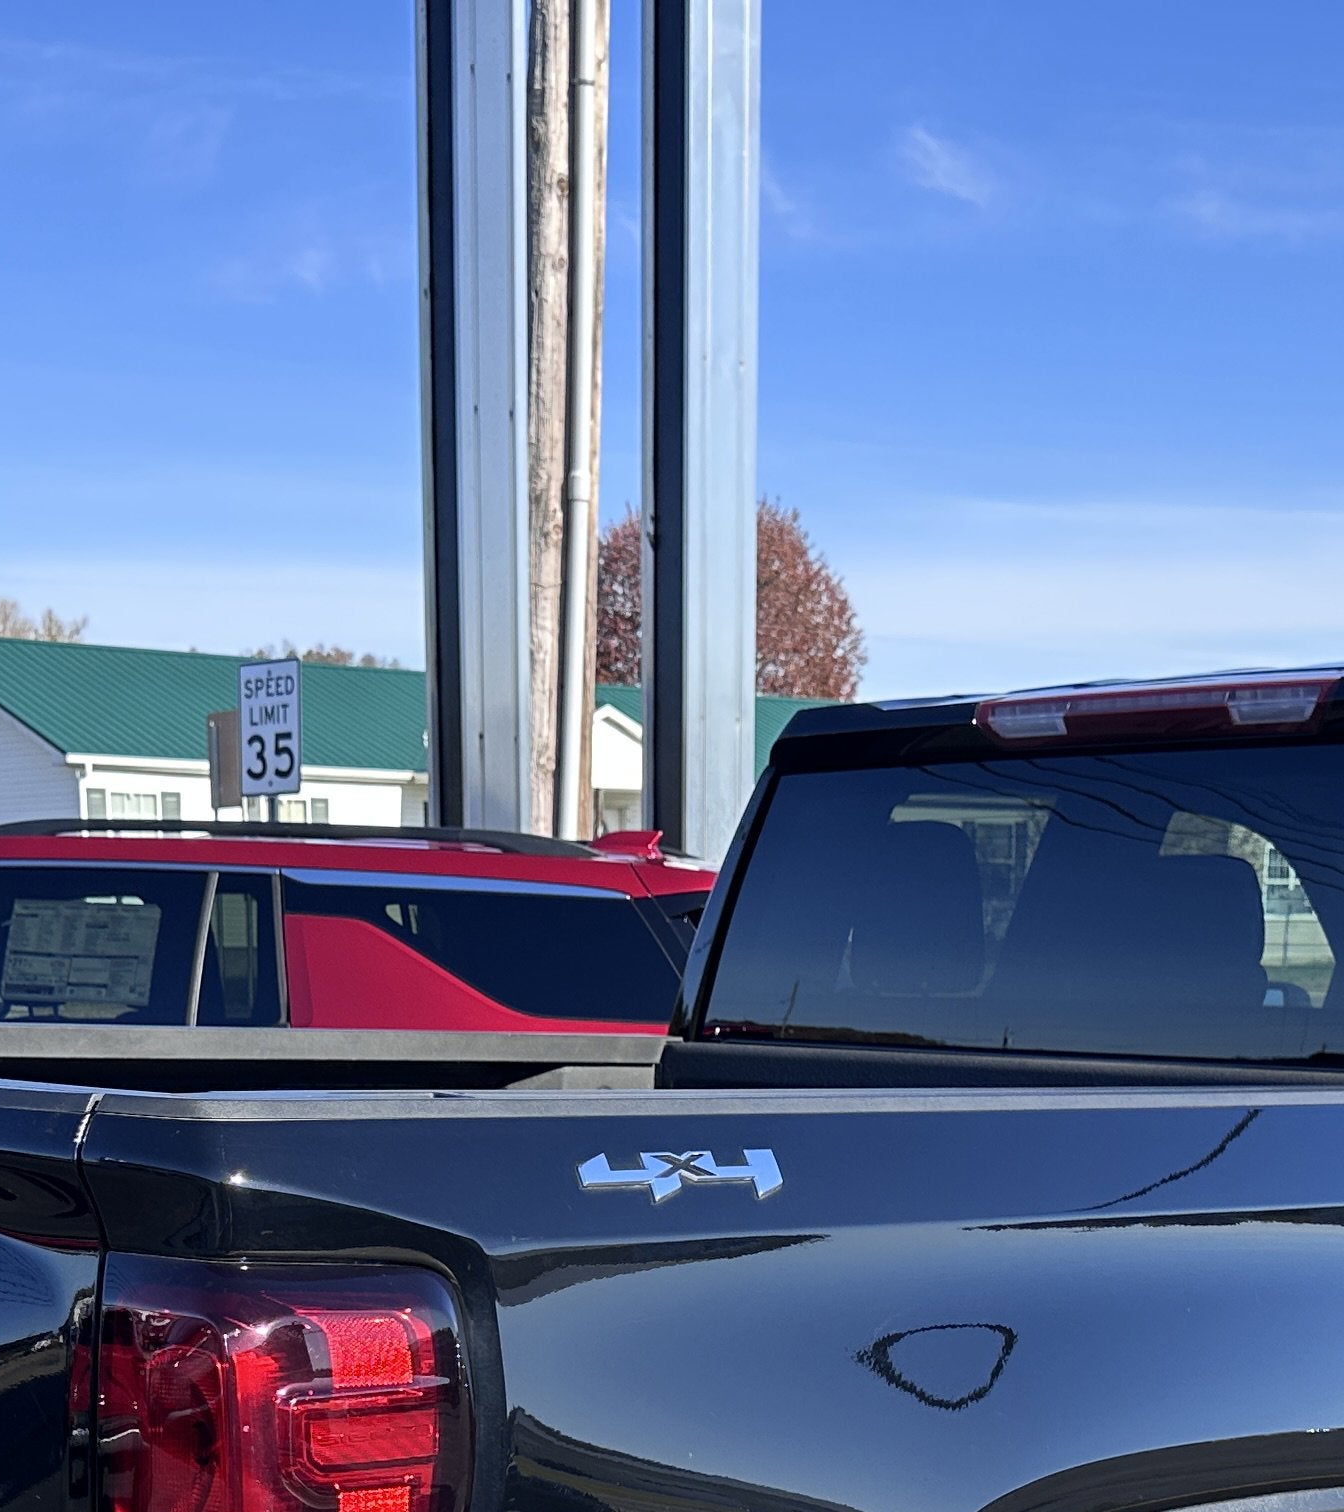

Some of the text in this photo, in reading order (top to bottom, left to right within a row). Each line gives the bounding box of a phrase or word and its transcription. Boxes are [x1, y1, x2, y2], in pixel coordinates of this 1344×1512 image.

[244, 675, 295, 699] SPEED
[249, 703, 290, 727] LIMIT
[246, 732, 295, 780] 35
